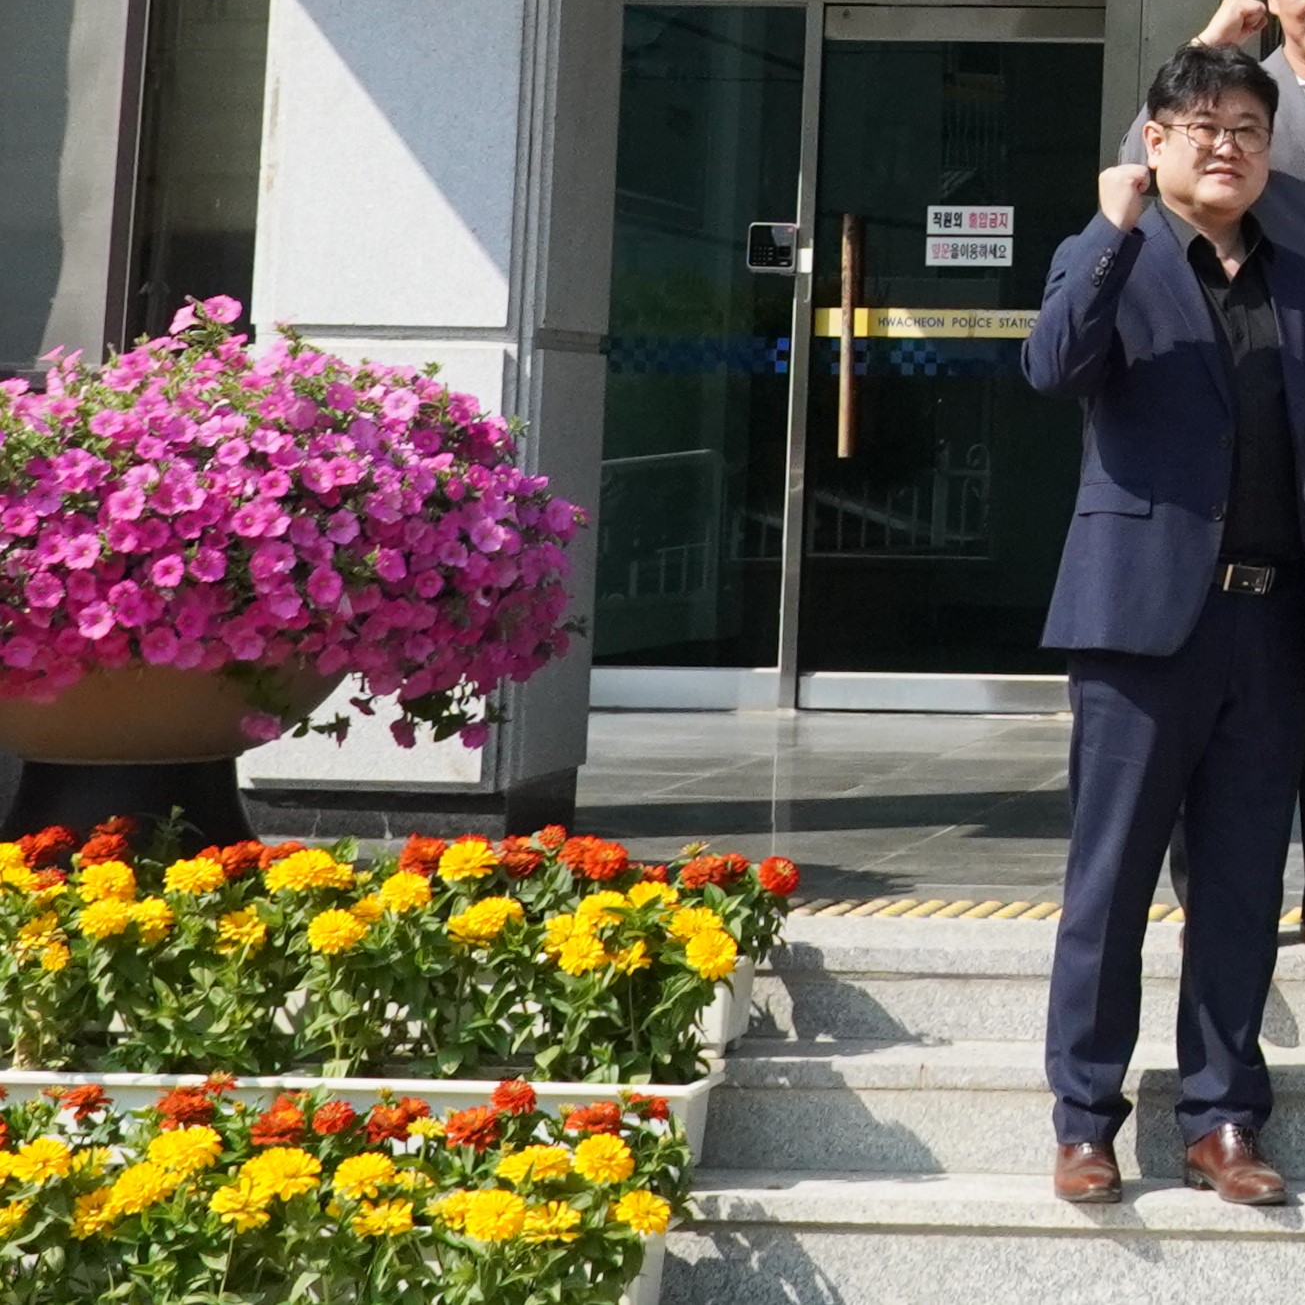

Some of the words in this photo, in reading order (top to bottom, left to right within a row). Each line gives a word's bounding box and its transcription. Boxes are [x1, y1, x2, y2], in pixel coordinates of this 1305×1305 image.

[969, 212, 1008, 229] 출입금지
[878, 316, 945, 328] HWACHEON
[951, 317, 992, 329] POLICE
[999, 317, 1038, 329] STATIO
